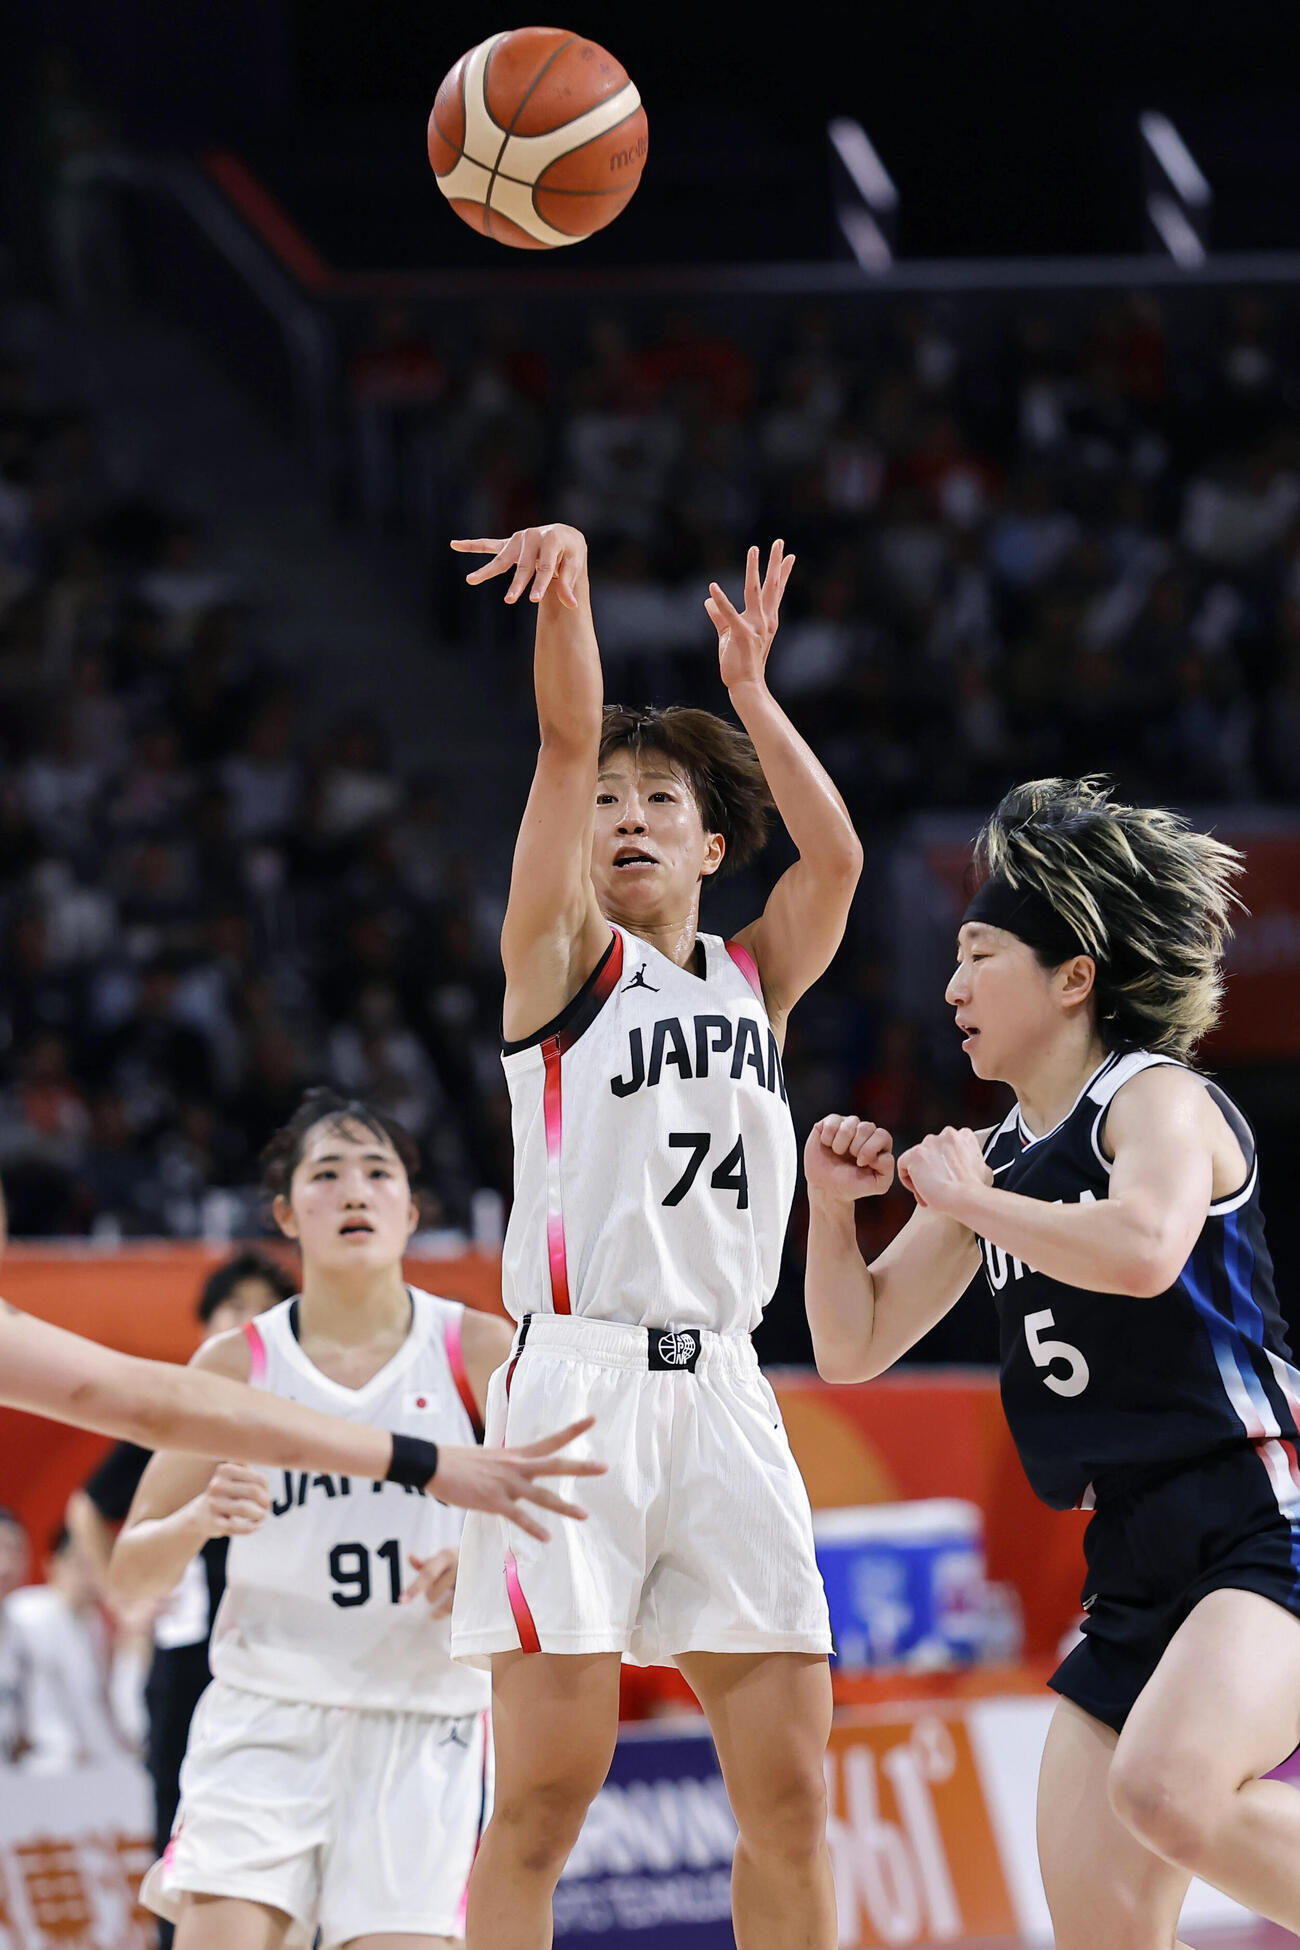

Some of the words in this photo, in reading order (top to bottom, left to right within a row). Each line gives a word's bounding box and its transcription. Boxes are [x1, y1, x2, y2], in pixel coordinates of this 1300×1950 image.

[611, 1015, 788, 1107] JAPAN
[662, 1132, 749, 1210] 74
[1024, 1308, 1090, 1397] 5
[329, 1539, 403, 1608] 91
